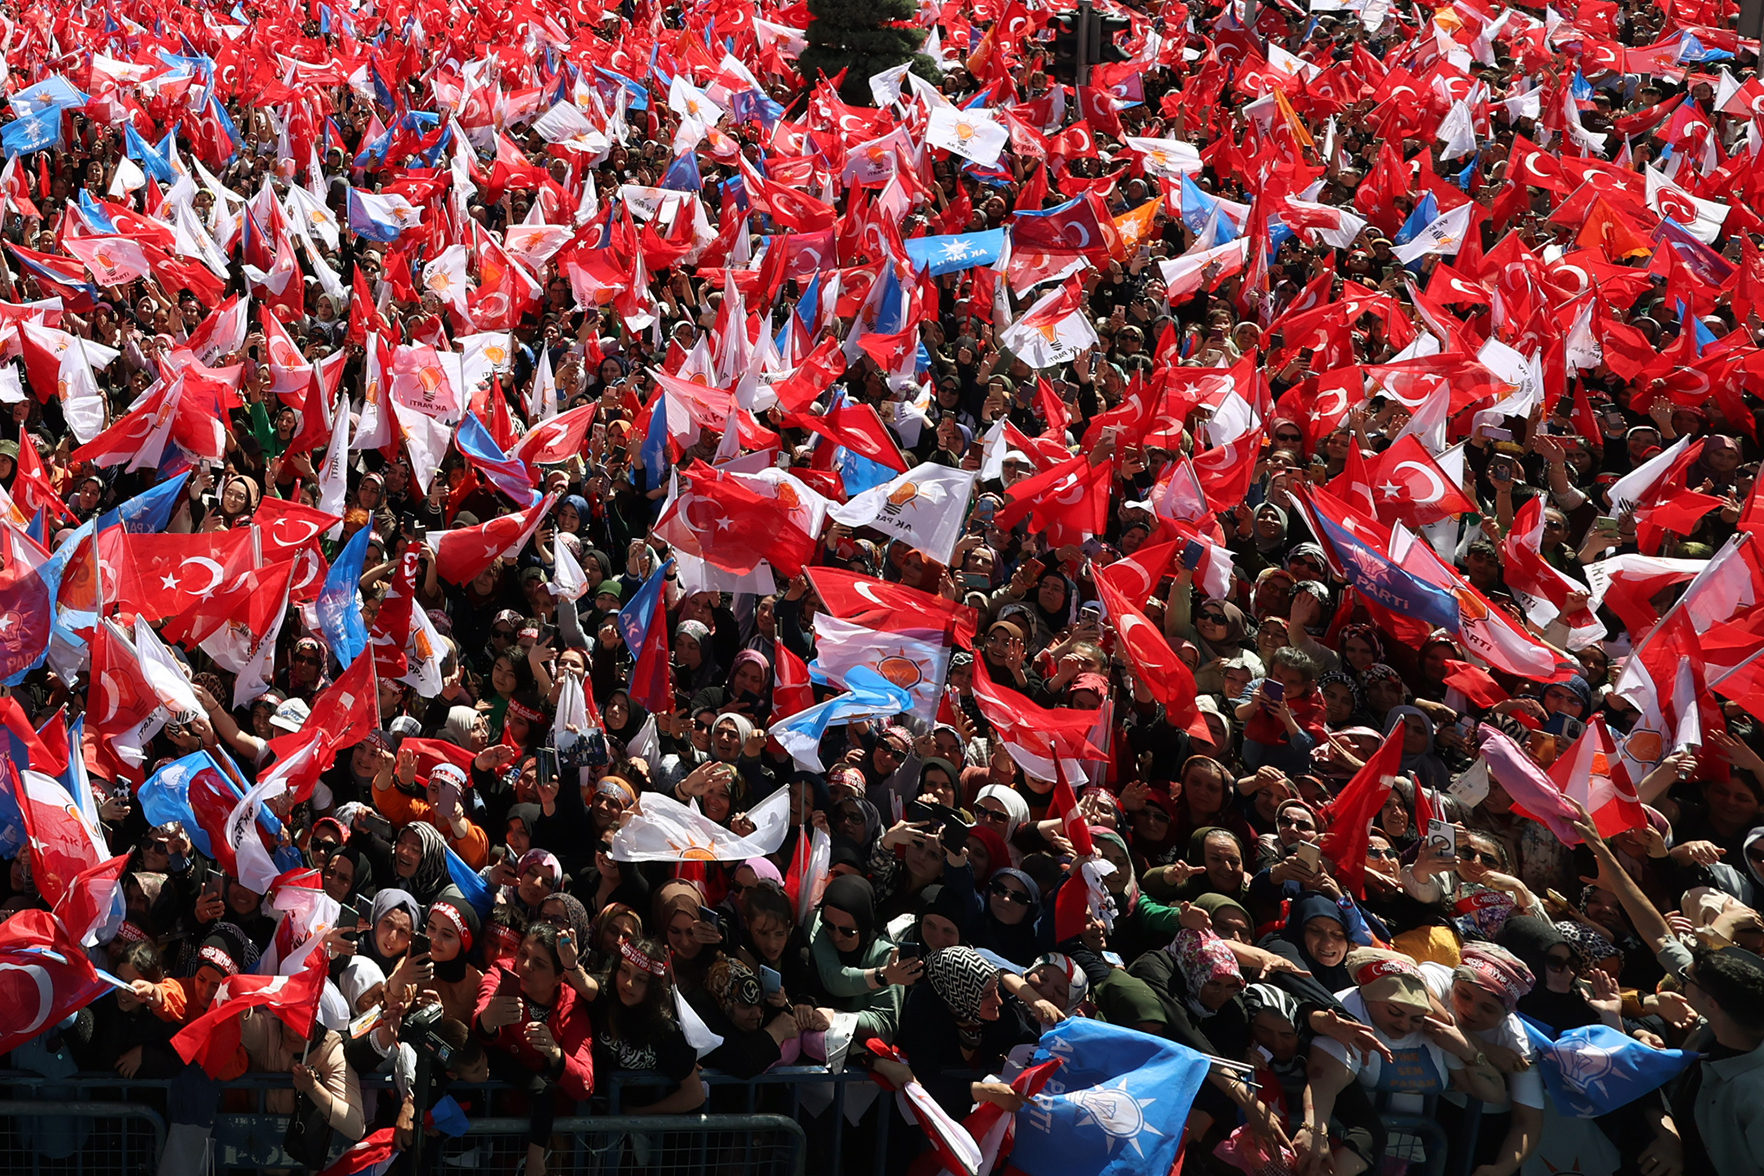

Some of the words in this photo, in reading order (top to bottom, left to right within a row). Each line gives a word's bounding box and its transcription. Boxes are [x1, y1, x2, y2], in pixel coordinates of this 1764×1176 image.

[1356, 575, 1409, 610] PARTİ
[1464, 630, 1493, 653] ARTİ
[60, 836, 80, 846] AK
[123, 929, 145, 944] ERDO
[126, 924, 141, 934] RECEP
[1398, 1067, 1423, 1075] SEN
[1029, 1080, 1065, 1134] PRTİ
